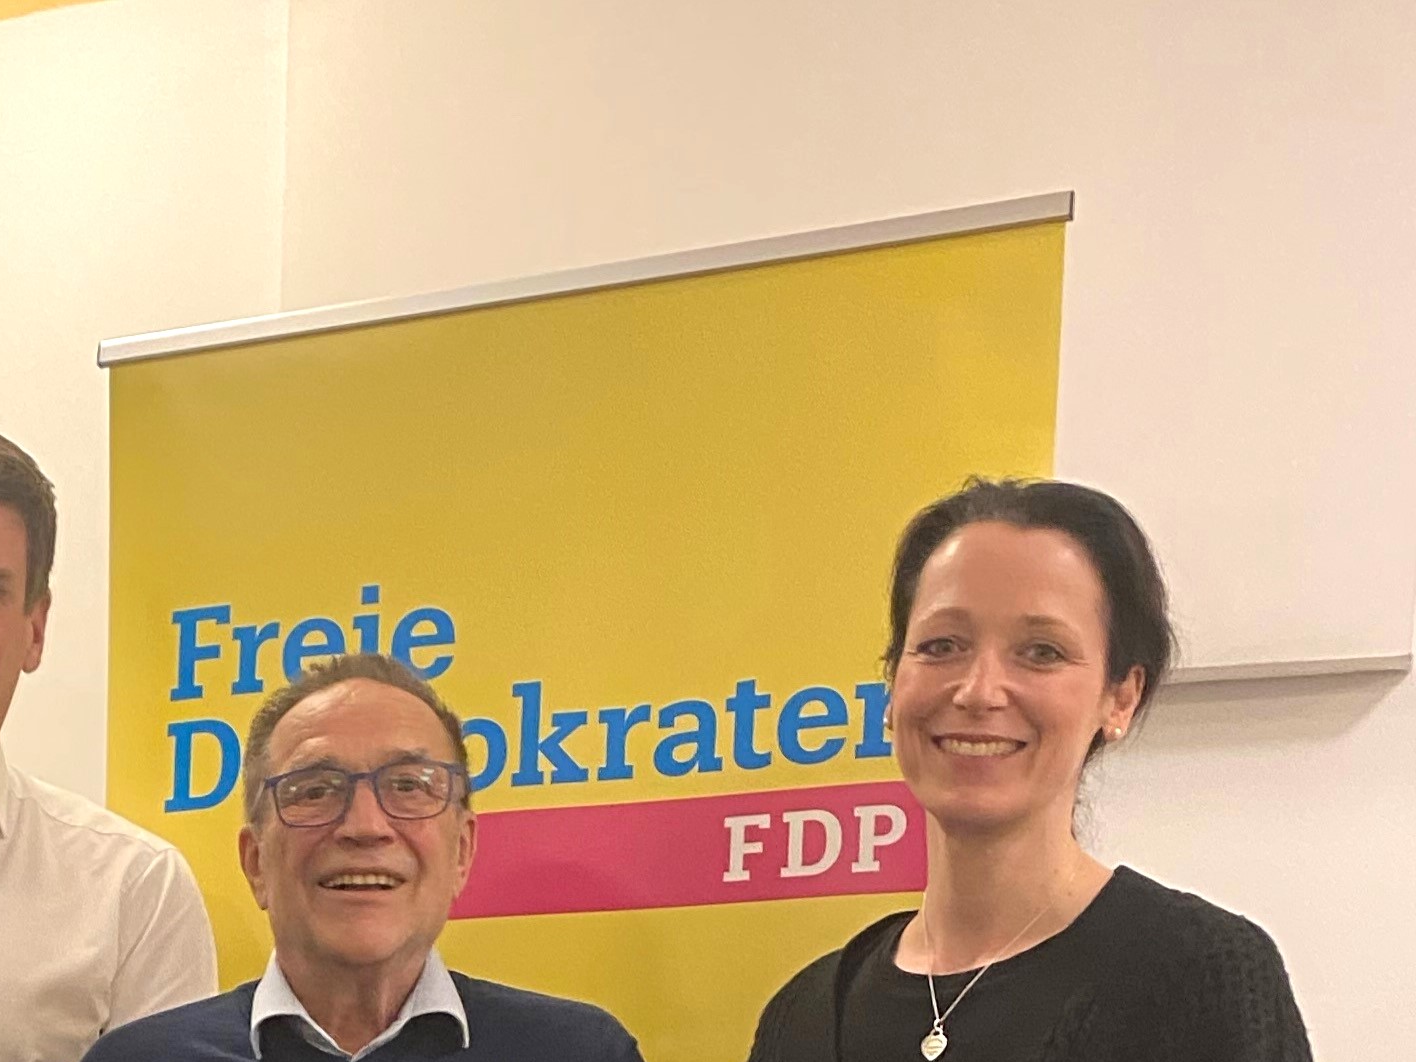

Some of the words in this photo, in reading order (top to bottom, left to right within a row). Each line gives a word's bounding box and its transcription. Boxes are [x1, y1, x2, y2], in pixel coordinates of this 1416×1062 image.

[170, 584, 456, 701] Freie
[164, 679, 892, 813] Dokrate
[722, 804, 908, 883] FDP
